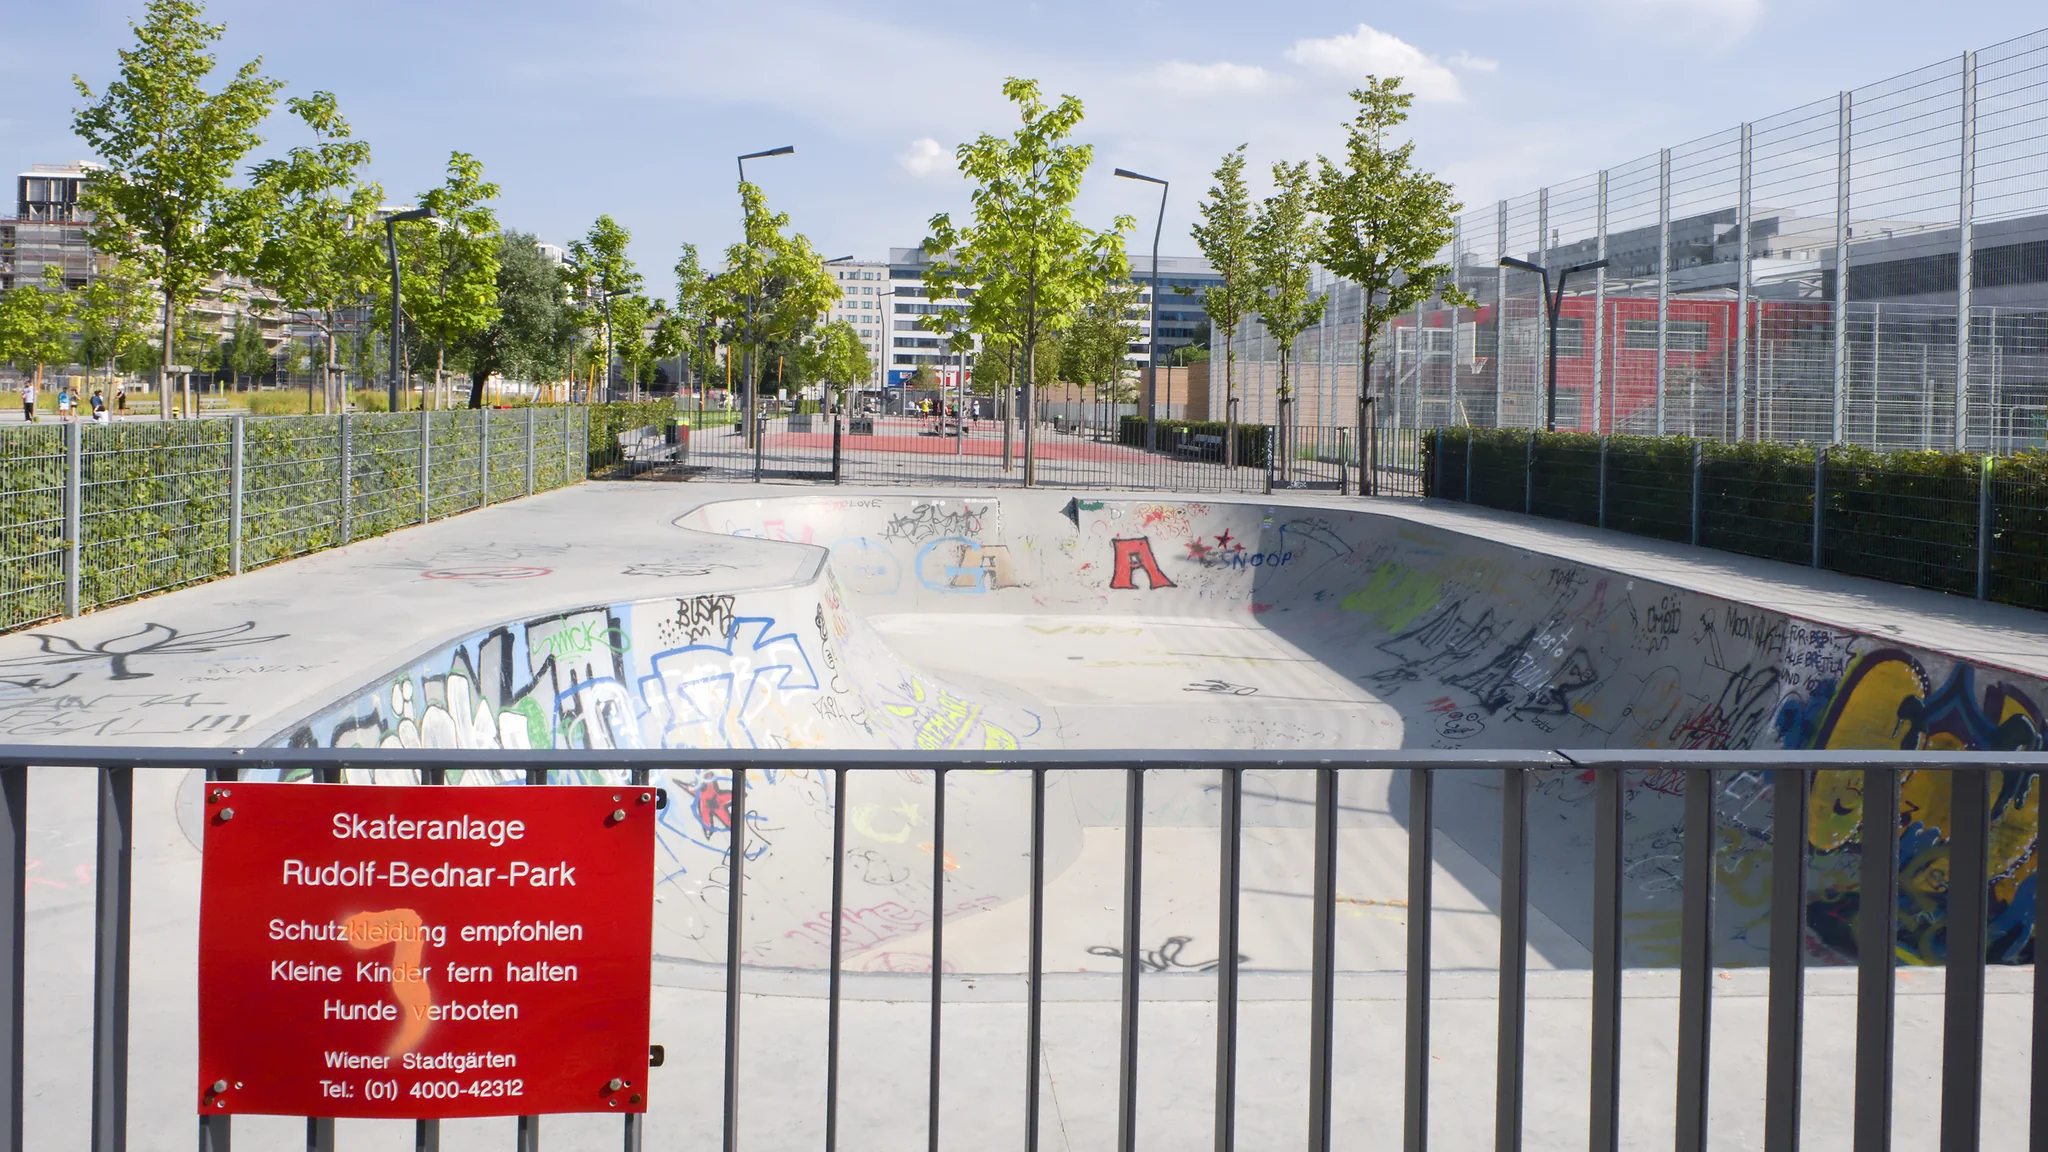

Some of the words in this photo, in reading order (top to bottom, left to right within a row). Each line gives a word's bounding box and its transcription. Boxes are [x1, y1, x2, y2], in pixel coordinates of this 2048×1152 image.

[1221, 551, 1292, 570] SNOOP
[333, 812, 526, 847] Skateranlage
[283, 859, 577, 887] Rudolf-Bednar-Park
[269, 919, 446, 948] Schutzkleidung
[461, 920, 583, 946] empfohlen
[271, 960, 342, 982] Kleine
[356, 961, 432, 983] Kinder
[447, 961, 493, 982] fern
[507, 961, 578, 982] halten
[324, 999, 397, 1020] Hunde
[412, 1000, 519, 1020] verboten
[324, 1051, 390, 1069] Wiener
[403, 1051, 516, 1073] Stadtgärten
[320, 1080, 354, 1098] Tel.:
[365, 1078, 398, 1101] (01)
[409, 1079, 524, 1099] 4000-42312
